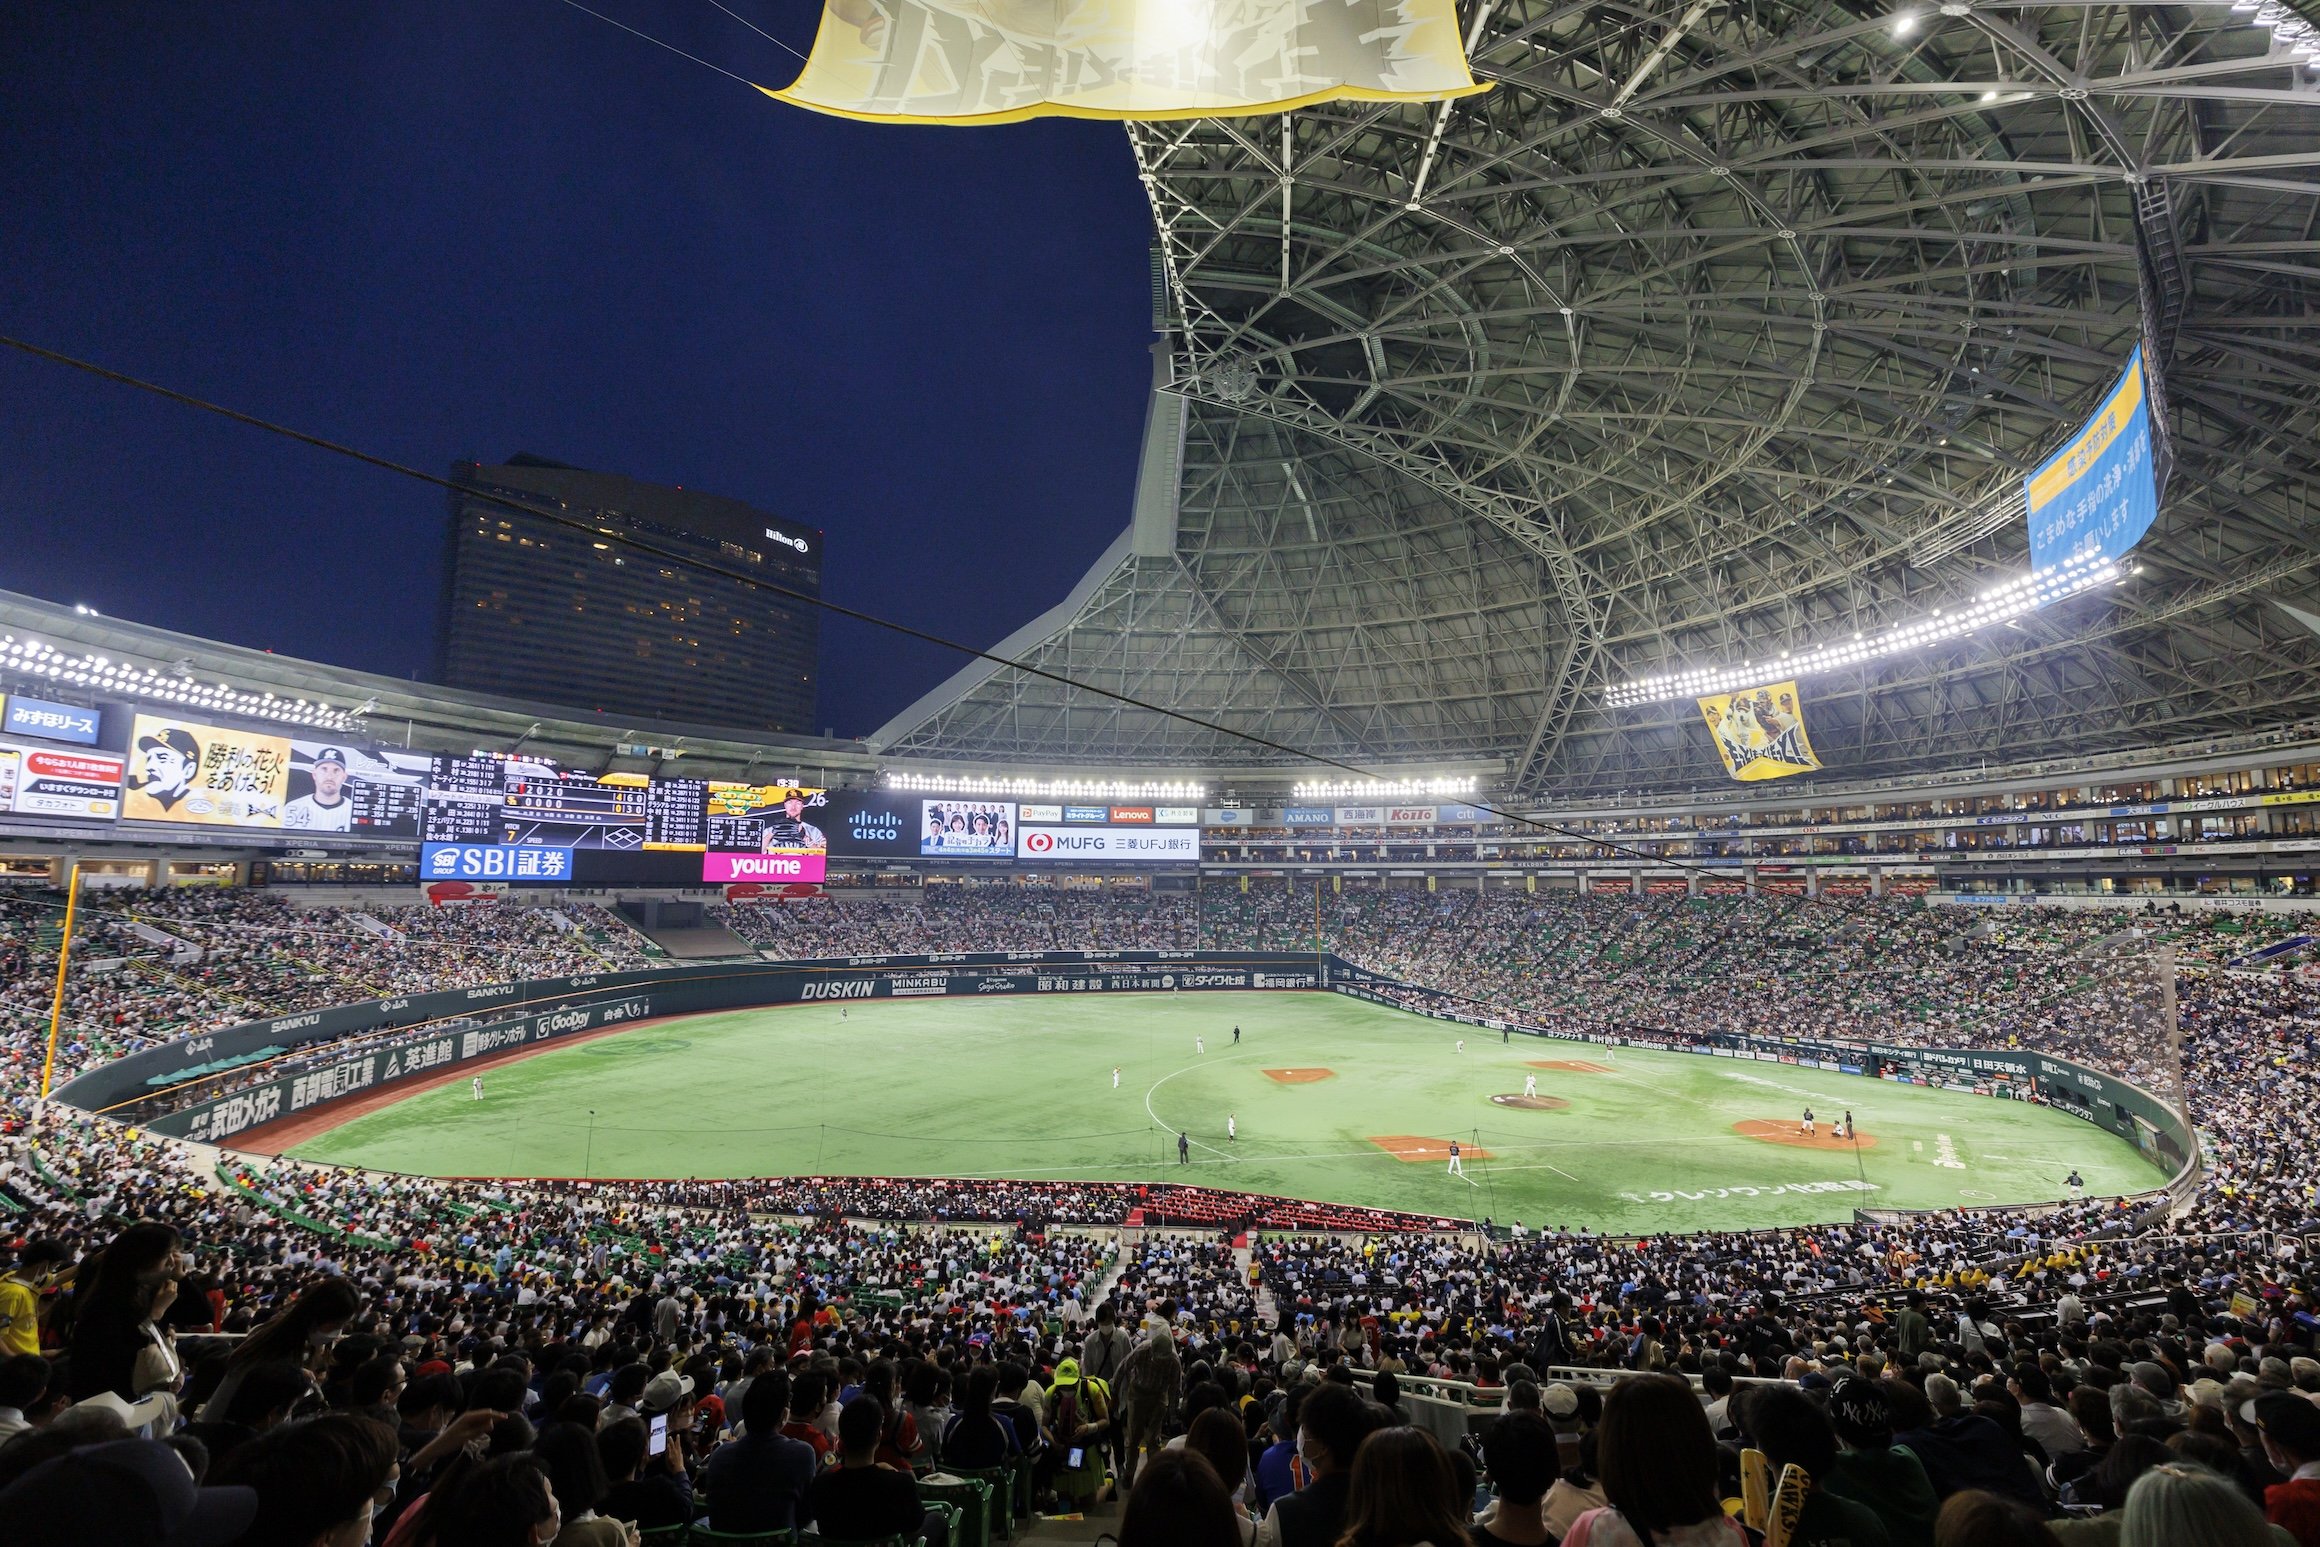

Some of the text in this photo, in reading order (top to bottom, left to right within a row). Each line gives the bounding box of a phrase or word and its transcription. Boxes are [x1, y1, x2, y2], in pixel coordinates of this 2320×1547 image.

[765, 528, 793, 546] Hilton
[13, 708, 94, 733] みずほリース
[204, 743, 284, 774] 勝利の花火
[808, 792, 826, 807] 26
[2193, 799, 2245, 809] イーグルハウス
[283, 806, 311, 828] 54
[1033, 810, 1059, 818] PayPay
[1114, 810, 1149, 820] Lenovo
[1287, 814, 1329, 823] AMANO
[1343, 809, 1376, 819] 西海岸
[1456, 811, 1475, 819] citi
[1056, 837, 1105, 850] MUFG
[1115, 838, 1191, 850] 三菱UFJ銀行
[433, 853, 456, 868] SBI
[462, 848, 565, 876] SBI証券
[730, 857, 801, 879] youme
[892, 978, 947, 988] MINKABU
[1037, 979, 1103, 990] 昭和建設
[1111, 978, 1160, 989] 西日本新聞
[1194, 975, 1246, 986] ダイワ化成
[1264, 978, 1306, 988] 福岡銀行
[467, 986, 514, 999] SANKYU
[801, 981, 875, 1000] DUSKIN
[270, 1014, 321, 1034] SANKYU
[551, 1012, 590, 1031] GooDay
[478, 1025, 527, 1053] 博多グリーンホテル
[1627, 1038, 1668, 1051] lendlease
[404, 1039, 453, 1074] 英進館
[1871, 1046, 1917, 1059] 西日本シティ銀行
[1923, 1052, 1966, 1066] ヨドバシカメラ
[1973, 1059, 2028, 1075] 日田天領水
[209, 1086, 282, 1141] 武田メガネ
[1754, 1324, 1774, 1338] STAFF
